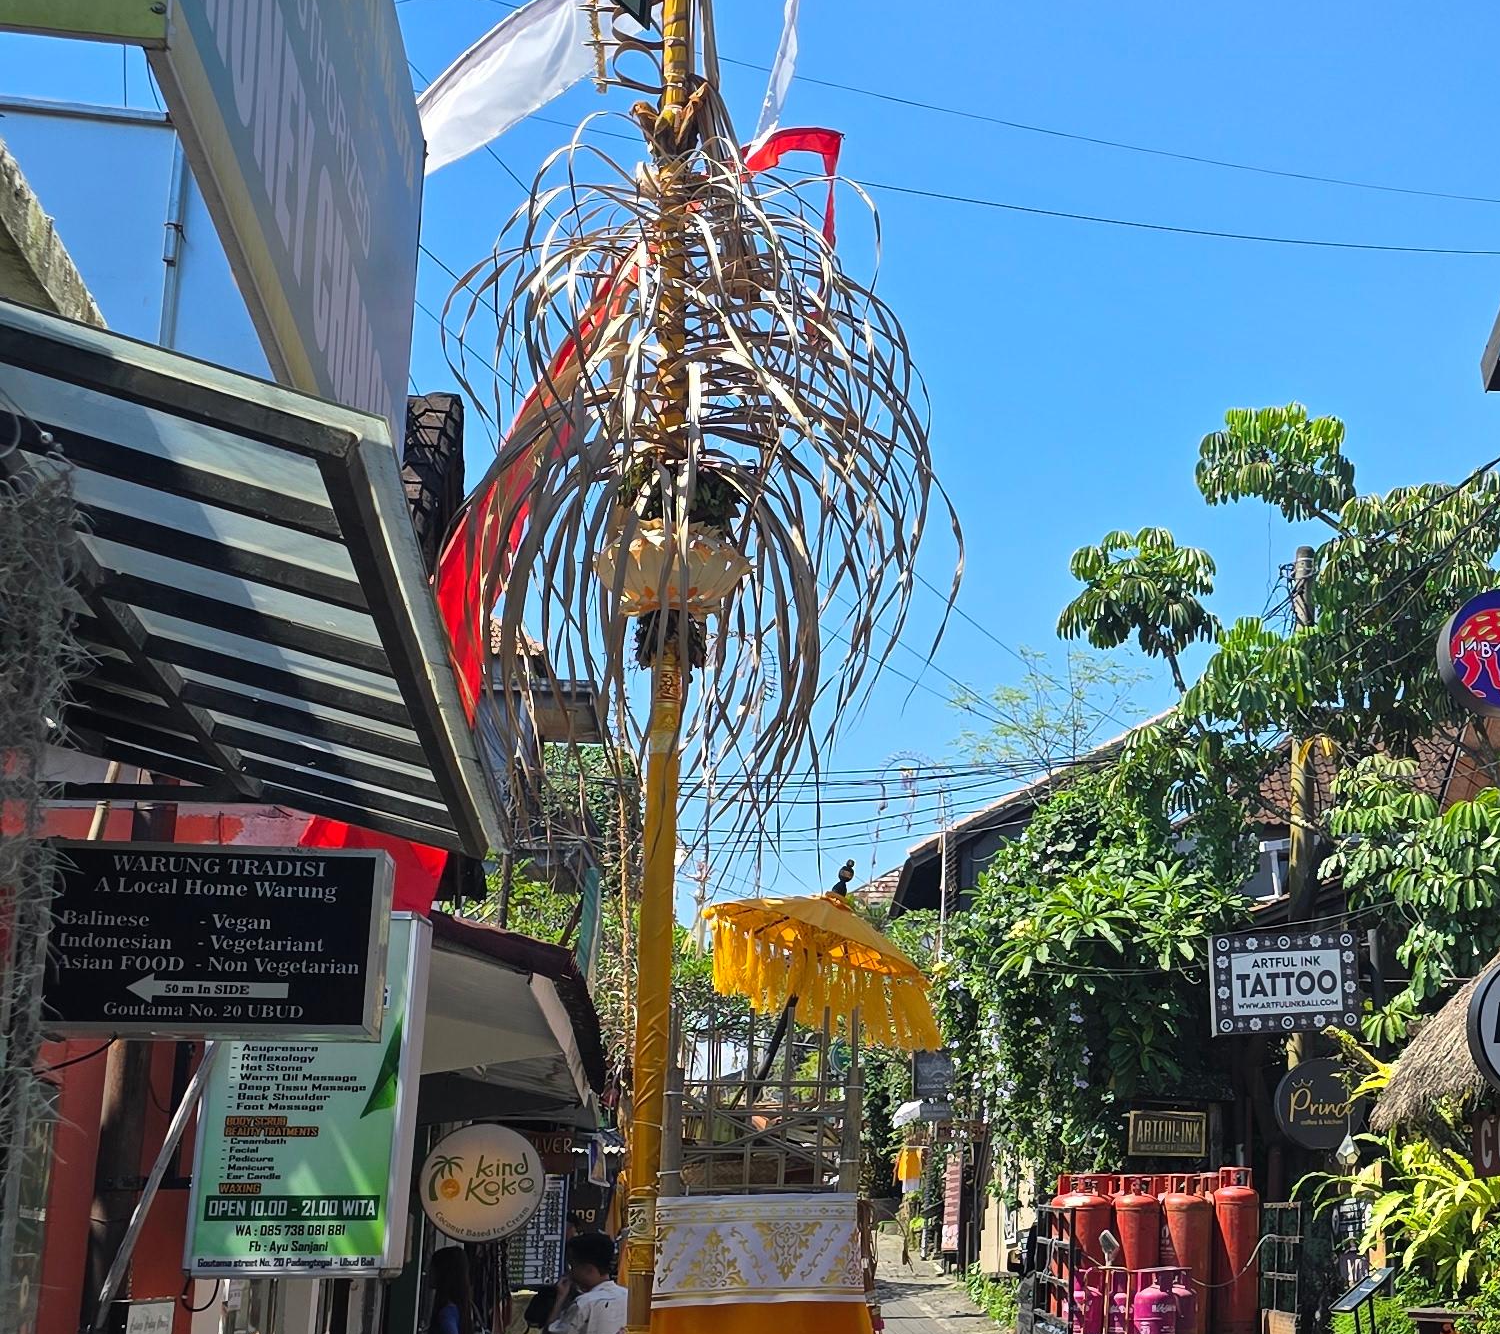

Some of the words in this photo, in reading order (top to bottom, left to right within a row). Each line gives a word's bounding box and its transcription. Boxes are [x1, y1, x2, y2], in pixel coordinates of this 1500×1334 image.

[113, 855, 220, 875] WARUNG
[227, 858, 327, 878] TRADISI
[94, 877, 111, 892] A
[117, 877, 177, 895] Local
[184, 879, 248, 897] Home
[255, 881, 338, 904] Warung
[63, 910, 150, 928] Balinese
[212, 914, 271, 933] Vegan
[60, 932, 172, 950] Indonesian
[210, 935, 325, 955] Vegetariant
[58, 954, 113, 971] Asian
[120, 955, 185, 972] FOOD
[207, 957, 248, 973] Non
[254, 958, 359, 977] Vegetarian
[1252, 957, 1298, 969] ARTFUL
[1300, 956, 1322, 967] INK
[164, 984, 179, 995] 50
[182, 986, 195, 995] m
[197, 984, 211, 995] In
[215, 984, 250, 995] SIDE
[1236, 969, 1338, 999] TATTOO
[103, 1002, 183, 1018] Goutama
[189, 1004, 218, 1018] No.
[223, 1004, 242, 1018] 20
[247, 1005, 304, 1019] UBUD
[241, 1054, 315, 1063] Reflexology
[240, 1064, 264, 1072] Hot
[266, 1064, 303, 1072] Stone
[302, 1074, 357, 1083] Massage
[238, 1084, 271, 1092] Deep
[312, 1084, 366, 1093] Massage
[237, 1093, 269, 1101] Back
[273, 1093, 331, 1101] Shoulder
[236, 1103, 265, 1111] Foot
[268, 1103, 324, 1112] Massage
[225, 1116, 254, 1127] BODY
[475, 1152, 529, 1179] kind
[219, 1183, 261, 1194] WAXING
[208, 1200, 246, 1217] OPEN
[250, 1200, 288, 1216] 10.00
[301, 1200, 338, 1216] 21.00
[342, 1199, 376, 1216] WITA
[435, 1212, 465, 1236] Coconut
[466, 1229, 491, 1238] Based
[493, 1226, 506, 1234] Ice
[505, 1206, 531, 1228] Cream
[235, 1225, 252, 1236] WA
[260, 1225, 281, 1236] 085
[285, 1225, 304, 1236] 738
[249, 1241, 261, 1252] Fb
[269, 1242, 289, 1254] Ayu
[291, 1241, 328, 1254] Sanjani
[273, 1258, 284, 1267] 20
[361, 1257, 375, 1266] Bali
